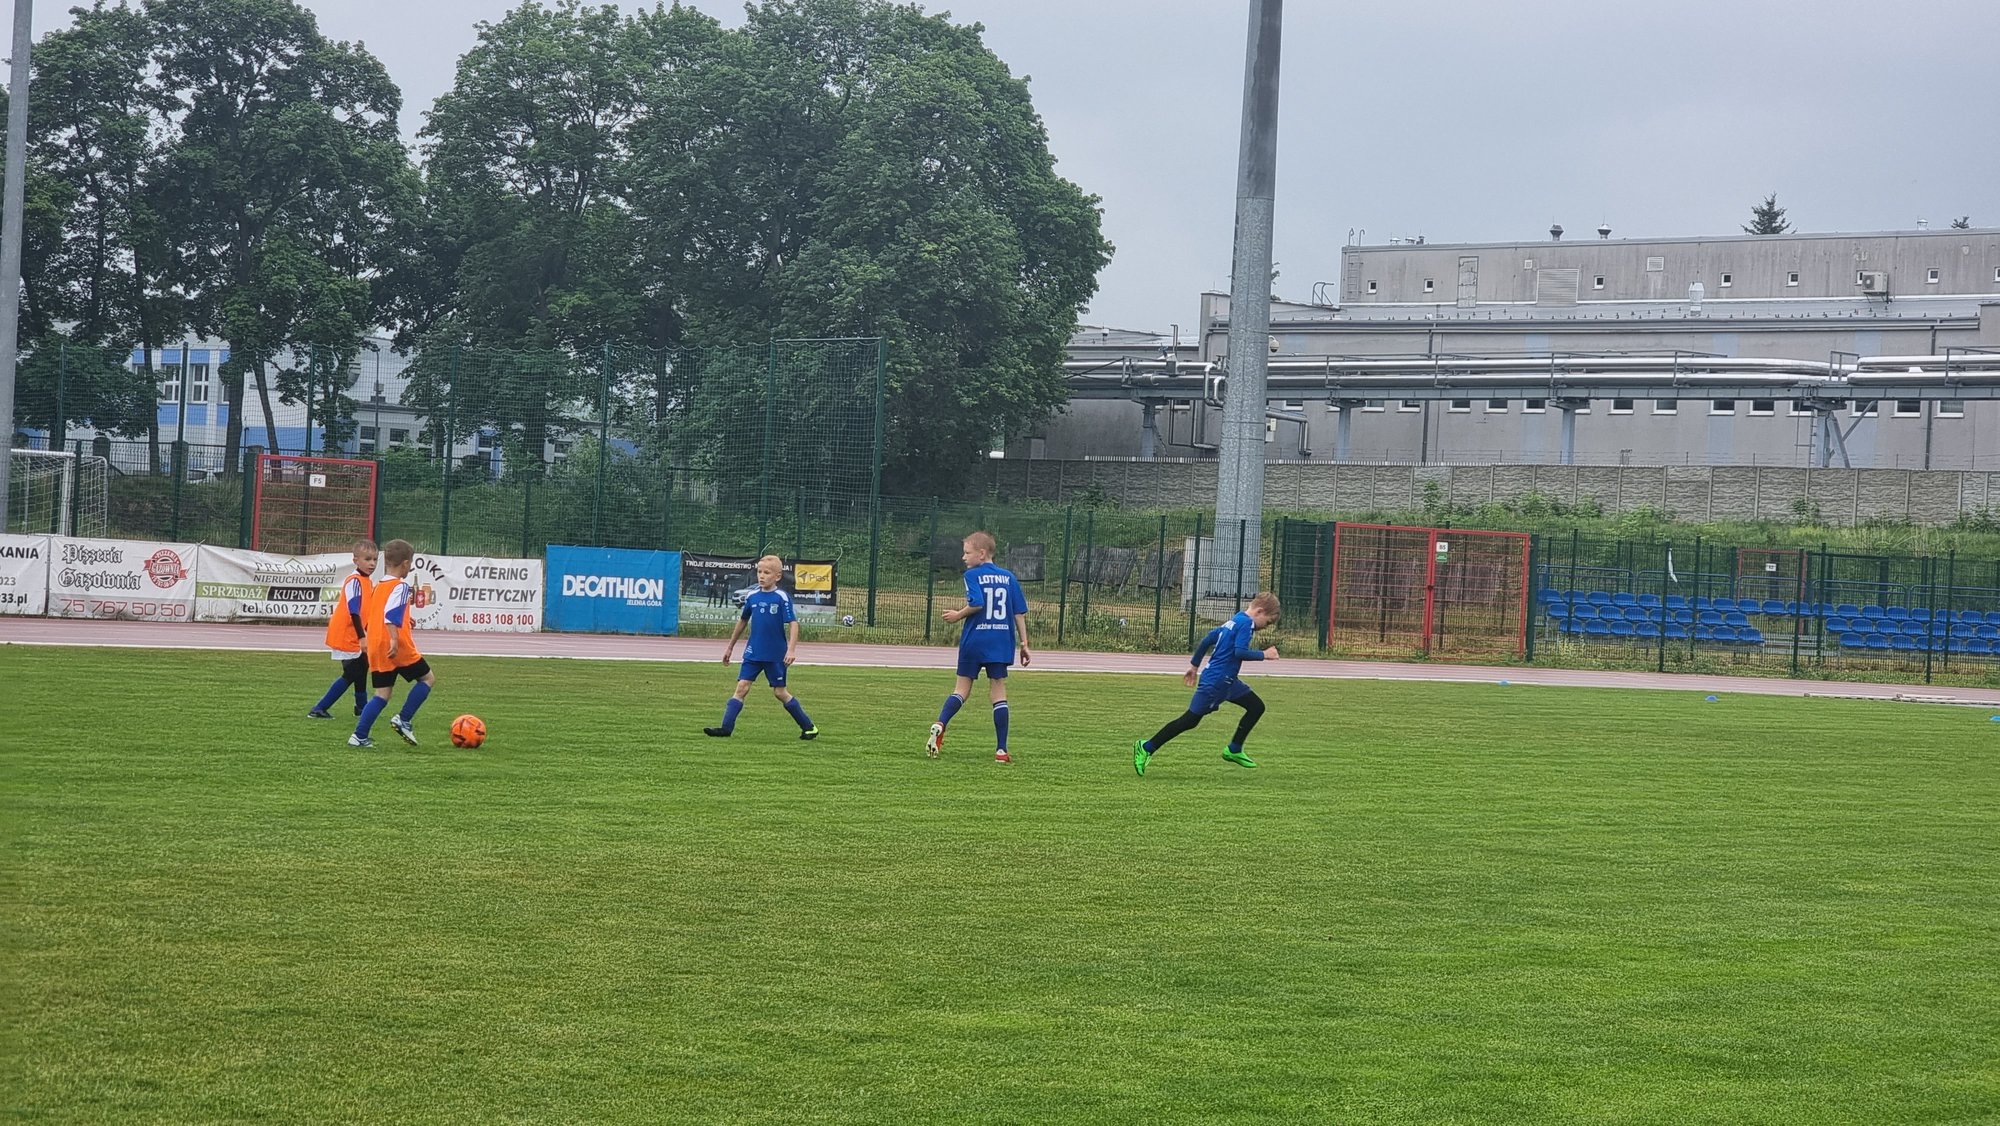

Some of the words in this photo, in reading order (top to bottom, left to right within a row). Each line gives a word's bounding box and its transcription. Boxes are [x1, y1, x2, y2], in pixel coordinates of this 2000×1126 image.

[62, 543, 123, 565] Pizzeria
[255, 561, 337, 574] PREMIUM
[410, 557, 445, 581] OIKI
[685, 560, 704, 568] TWOJE
[58, 567, 141, 591] Gazownia
[253, 574, 335, 584] NIERUCHOMOŚCI
[464, 565, 528, 581] CATERING
[809, 573, 830, 582] Piast
[978, 574, 1010, 585] LOTNIK
[202, 585, 263, 599] SPRZEDAŻ
[273, 589, 315, 600] KUPNO
[562, 574, 664, 600] DECATHLON
[449, 587, 537, 603] DIETETYCZNY
[60, 599, 85, 613] 75
[90, 600, 128, 614] 767
[132, 602, 156, 616] 50
[161, 603, 186, 617] 50
[242, 602, 262, 614] tel.
[265, 603, 289, 615] 600
[293, 604, 316, 615] 227
[320, 604, 334, 615] 51
[983, 587, 1007, 620] 13
[453, 613, 468, 624] tel.
[472, 613, 491, 625] 883
[495, 614, 513, 625] 108
[517, 615, 534, 625] 100
